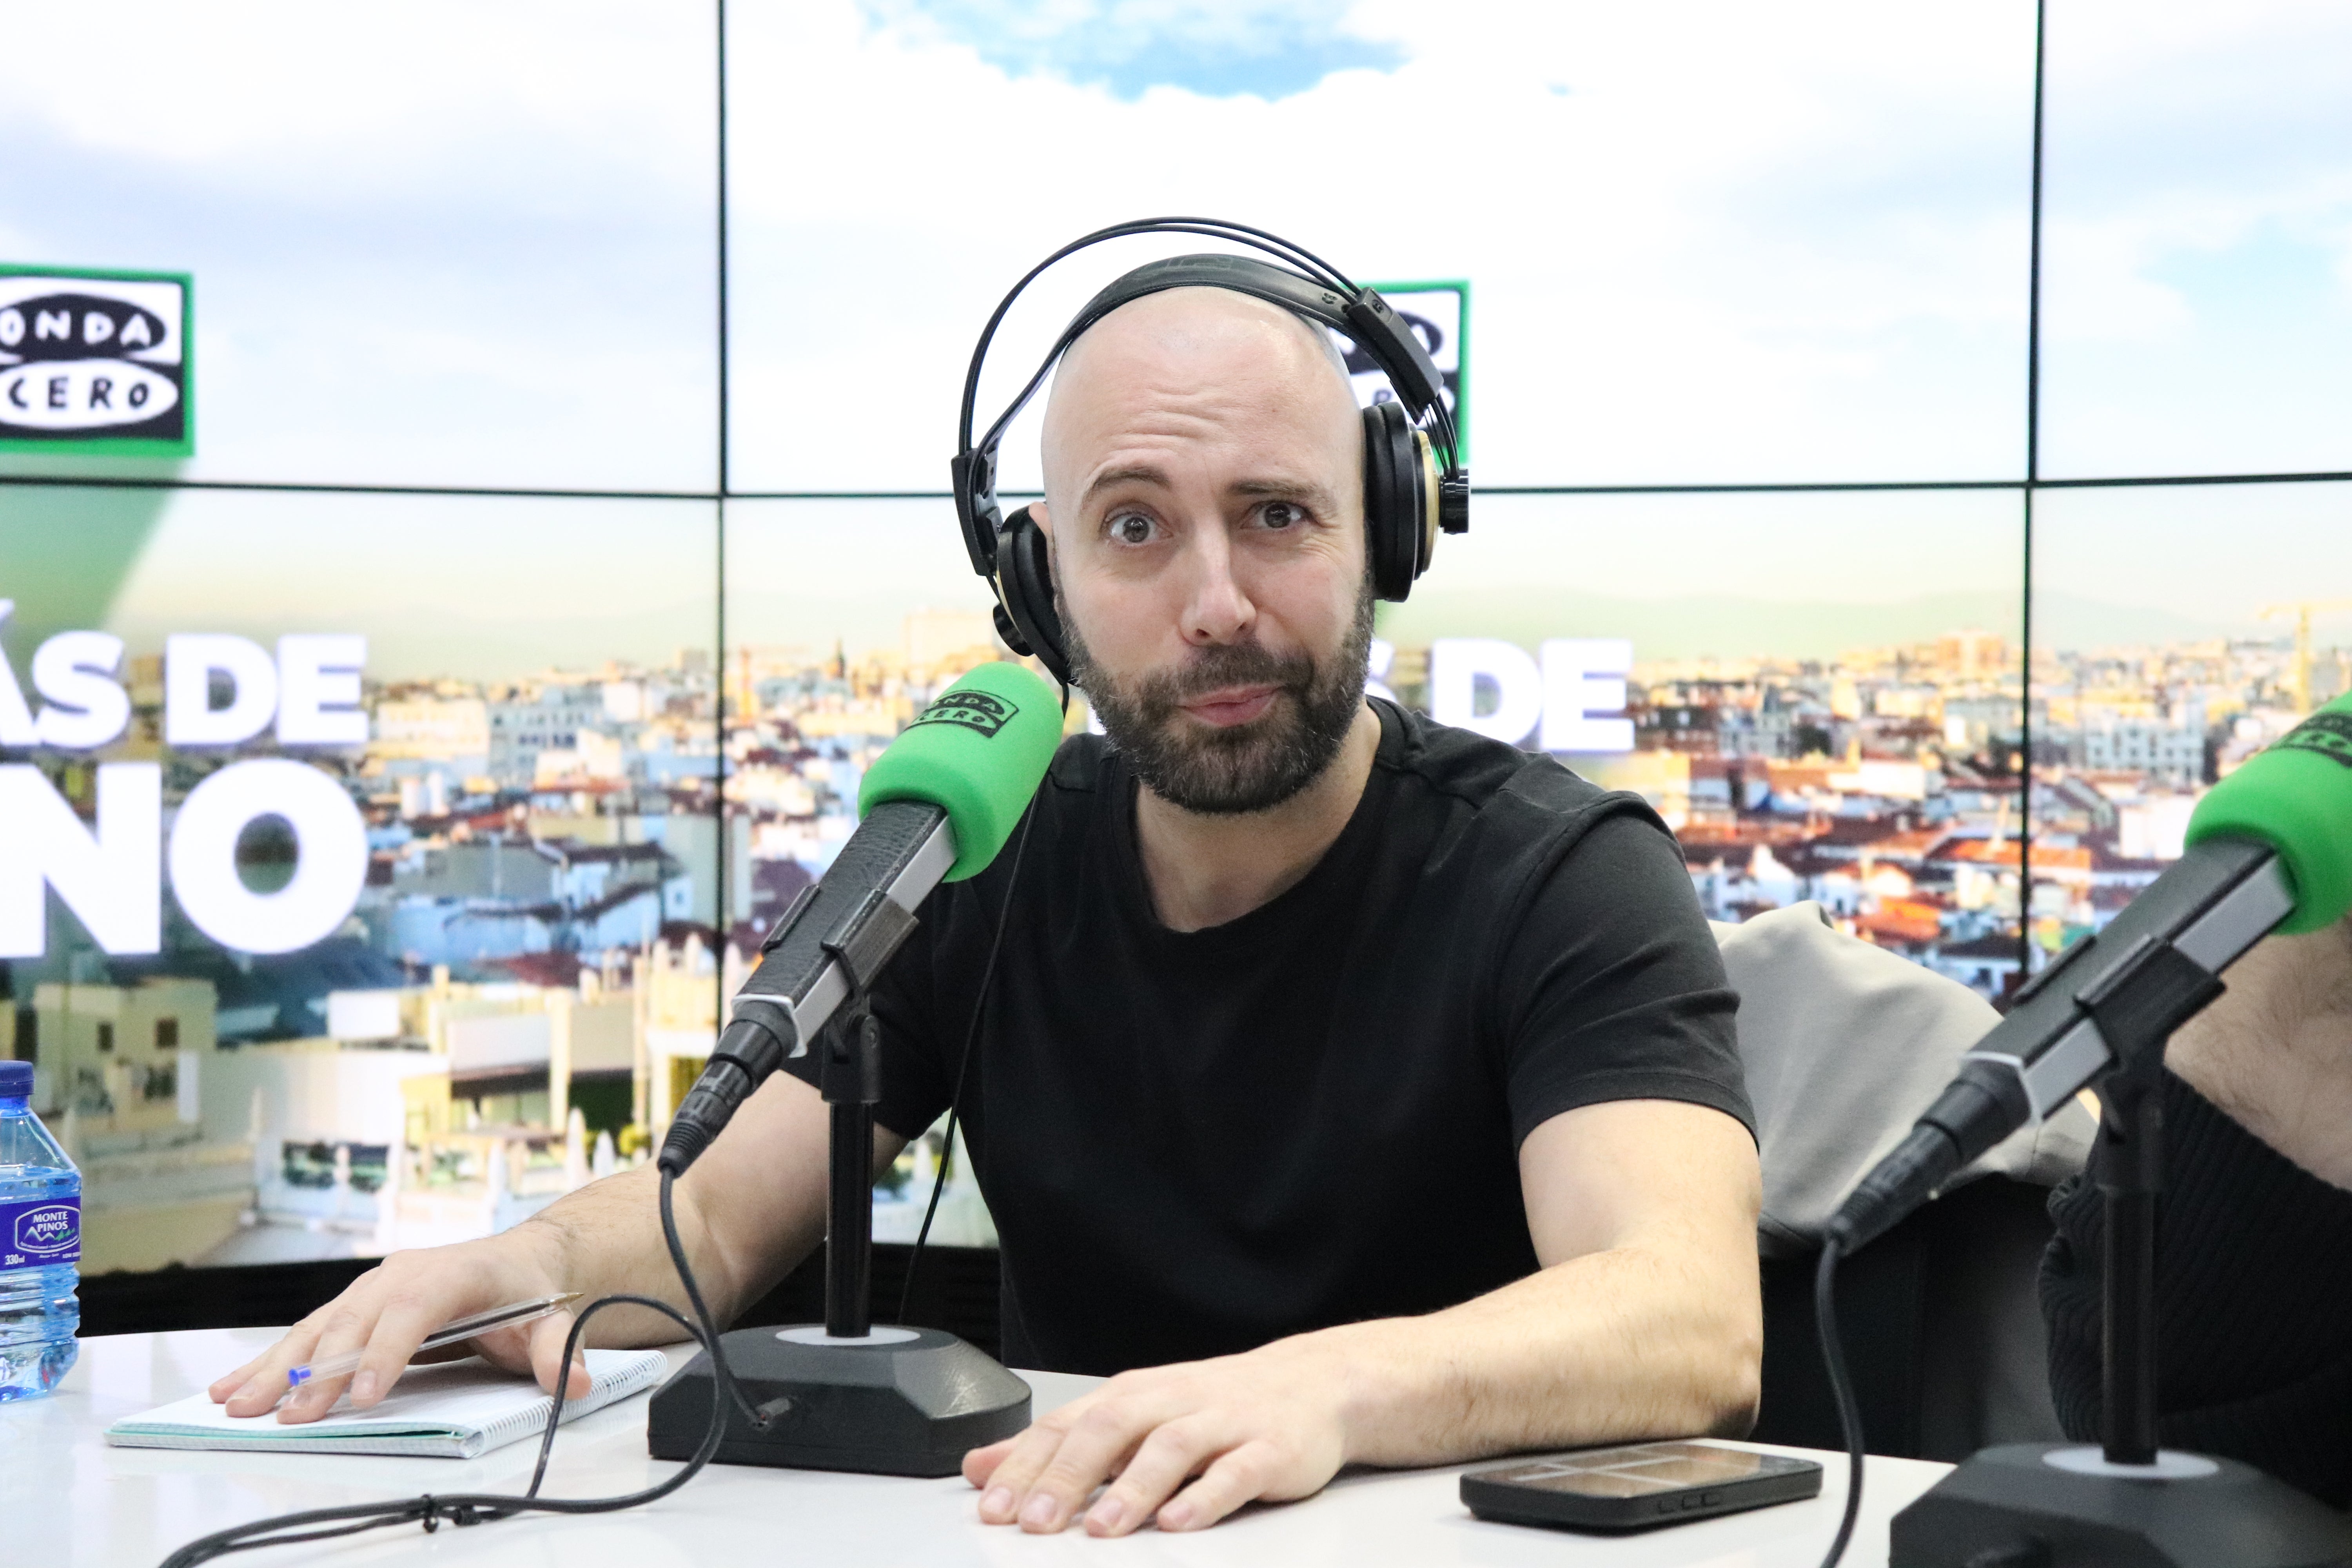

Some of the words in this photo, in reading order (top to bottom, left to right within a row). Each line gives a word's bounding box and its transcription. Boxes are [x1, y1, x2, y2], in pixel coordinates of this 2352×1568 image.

[0, 309, 152, 346] ONDA
[8, 377, 150, 408] CERO
[165, 633, 368, 745] DE
[1432, 638, 1635, 750] DE
[33, 1211, 68, 1223] MONTE
[38, 1221, 68, 1232] PINOS
